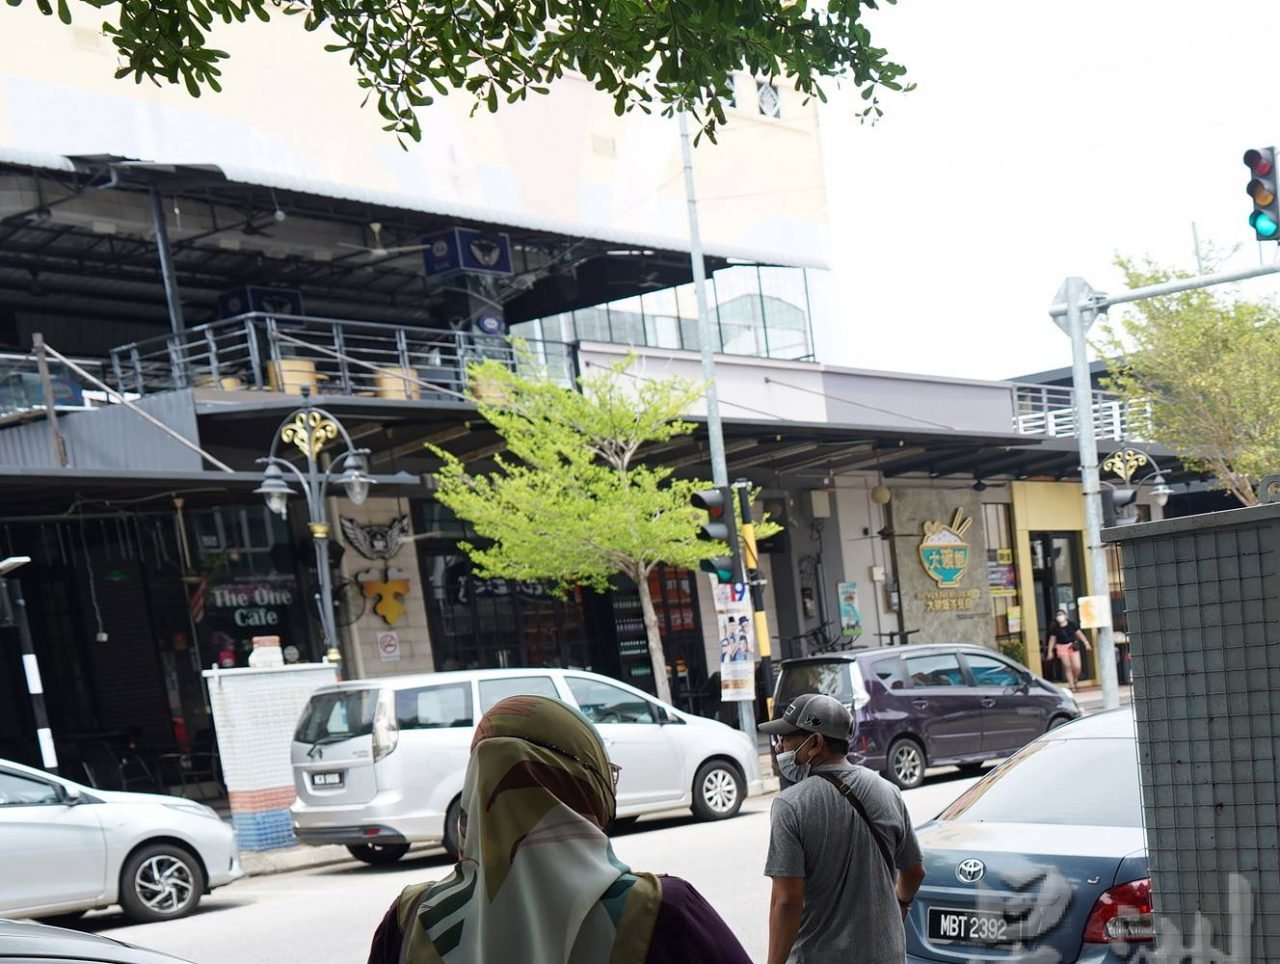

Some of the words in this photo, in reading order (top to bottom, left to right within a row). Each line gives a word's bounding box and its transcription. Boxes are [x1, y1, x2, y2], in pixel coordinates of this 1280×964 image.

[211, 589, 248, 608] The
[254, 587, 293, 606] One
[940, 914, 967, 937] MBT
[969, 918, 1008, 940] 2392
